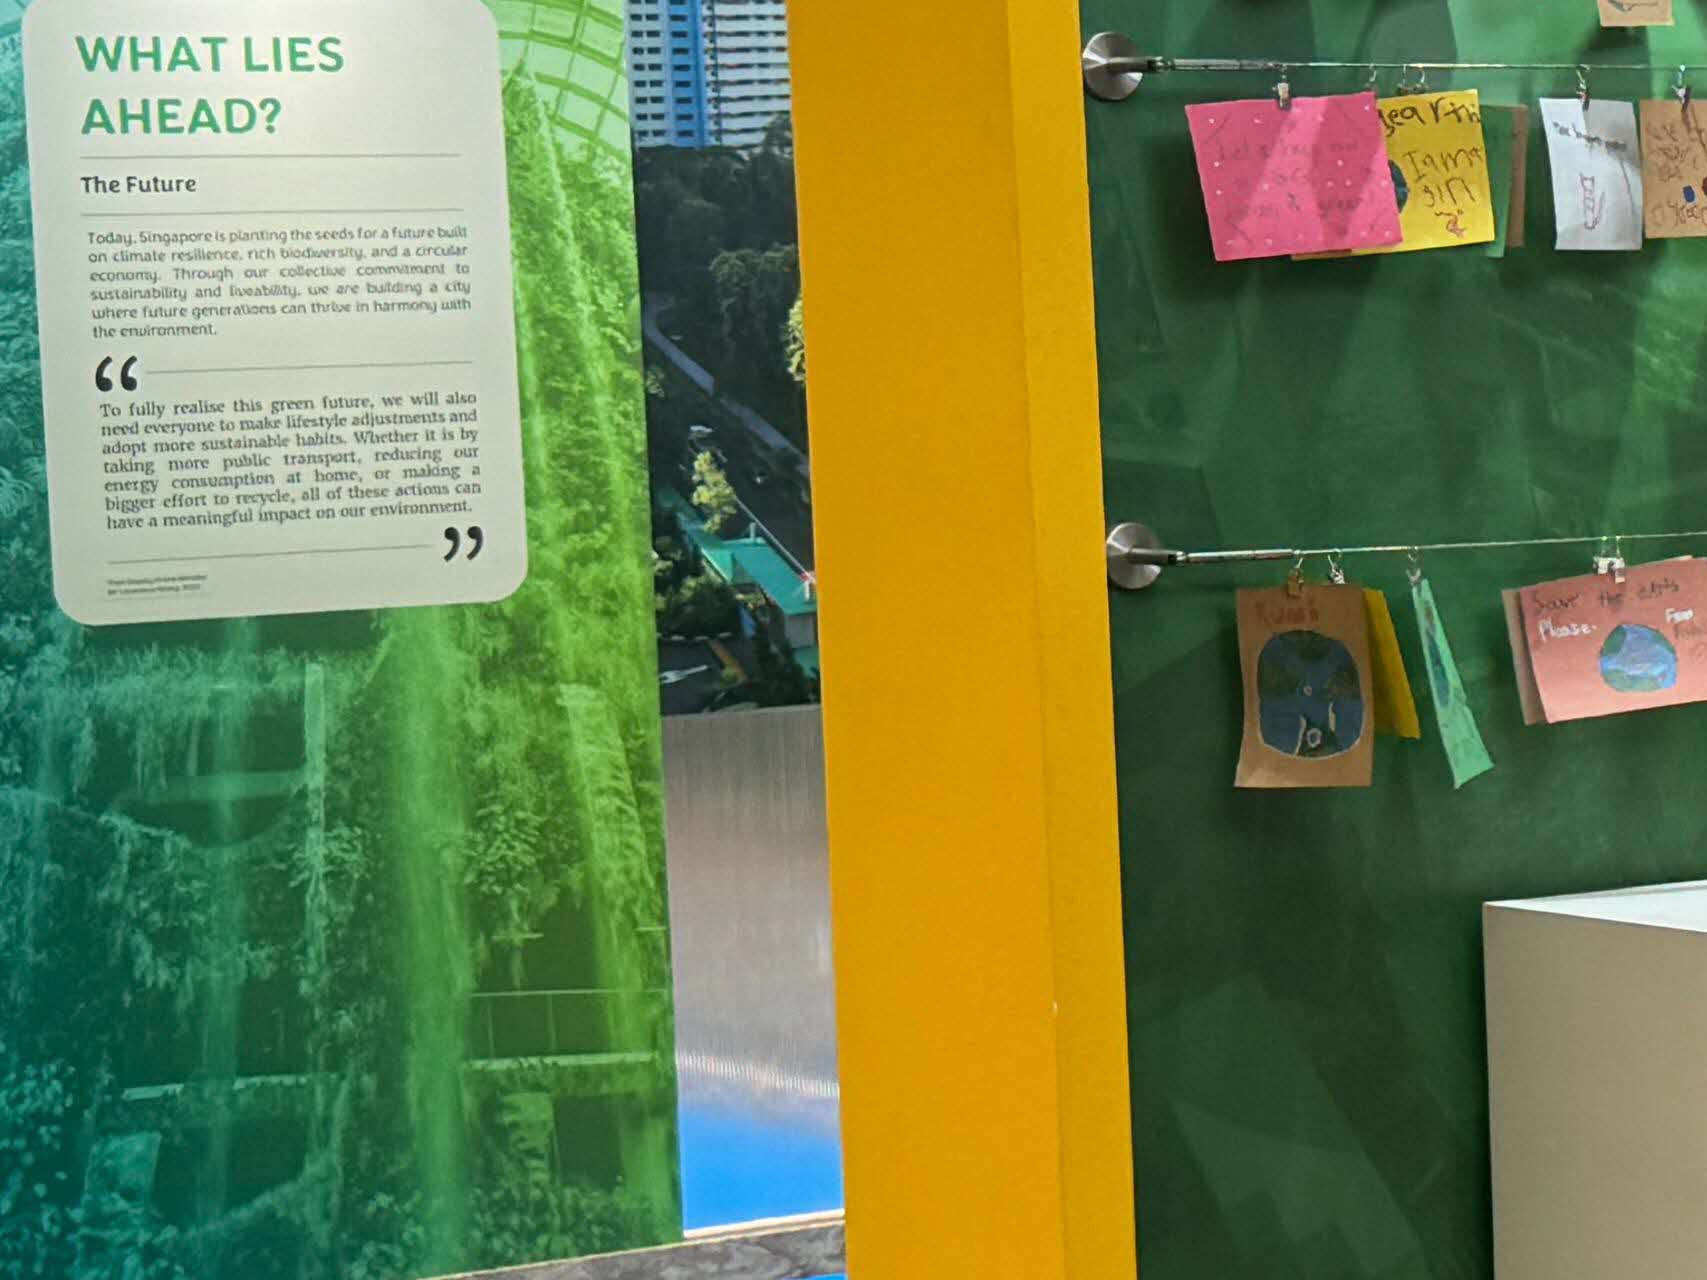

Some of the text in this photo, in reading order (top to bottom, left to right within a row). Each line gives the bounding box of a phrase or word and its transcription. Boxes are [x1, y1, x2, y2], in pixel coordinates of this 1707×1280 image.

[75, 35, 343, 72] WHAT LIES
[81, 97, 280, 134] AHEAD?
[80, 176, 195, 193] The Future
[99, 403, 121, 417] To
[129, 400, 165, 419] fully
[173, 399, 224, 415] realise
[233, 399, 262, 412] this
[271, 400, 314, 414] green
[381, 396, 402, 406] we
[409, 392, 438, 405] will
[445, 391, 476, 404] also
[101, 408, 477, 436] need everyone to make lifestyle adjustments and
[102, 440, 146, 457] adopt
[153, 441, 195, 452] more
[201, 434, 289, 451] sustainable
[353, 429, 418, 444] Whether
[425, 429, 436, 441] it
[442, 428, 454, 440] is
[460, 427, 478, 442] by
[103, 457, 154, 475] taking
[168, 456, 209, 471] more
[222, 453, 270, 471] public
[374, 446, 442, 464] reducing
[453, 447, 478, 458] our
[104, 479, 159, 494] energy
[171, 472, 274, 489] consumption
[286, 471, 300, 483] at
[374, 469, 390, 479] or
[402, 463, 460, 480] making
[472, 465, 480, 475] a
[105, 496, 156, 513] bigger
[160, 493, 206, 508] effort
[213, 494, 229, 505] to
[301, 487, 320, 501] all
[326, 486, 342, 499] of
[347, 485, 389, 499] these
[394, 483, 449, 496] actions
[454, 482, 481, 494] can
[107, 515, 144, 529] have
[147, 517, 157, 527] a
[162, 508, 252, 527] meaningful
[258, 507, 311, 524] impact
[316, 508, 335, 519] on
[338, 506, 365, 517] our
